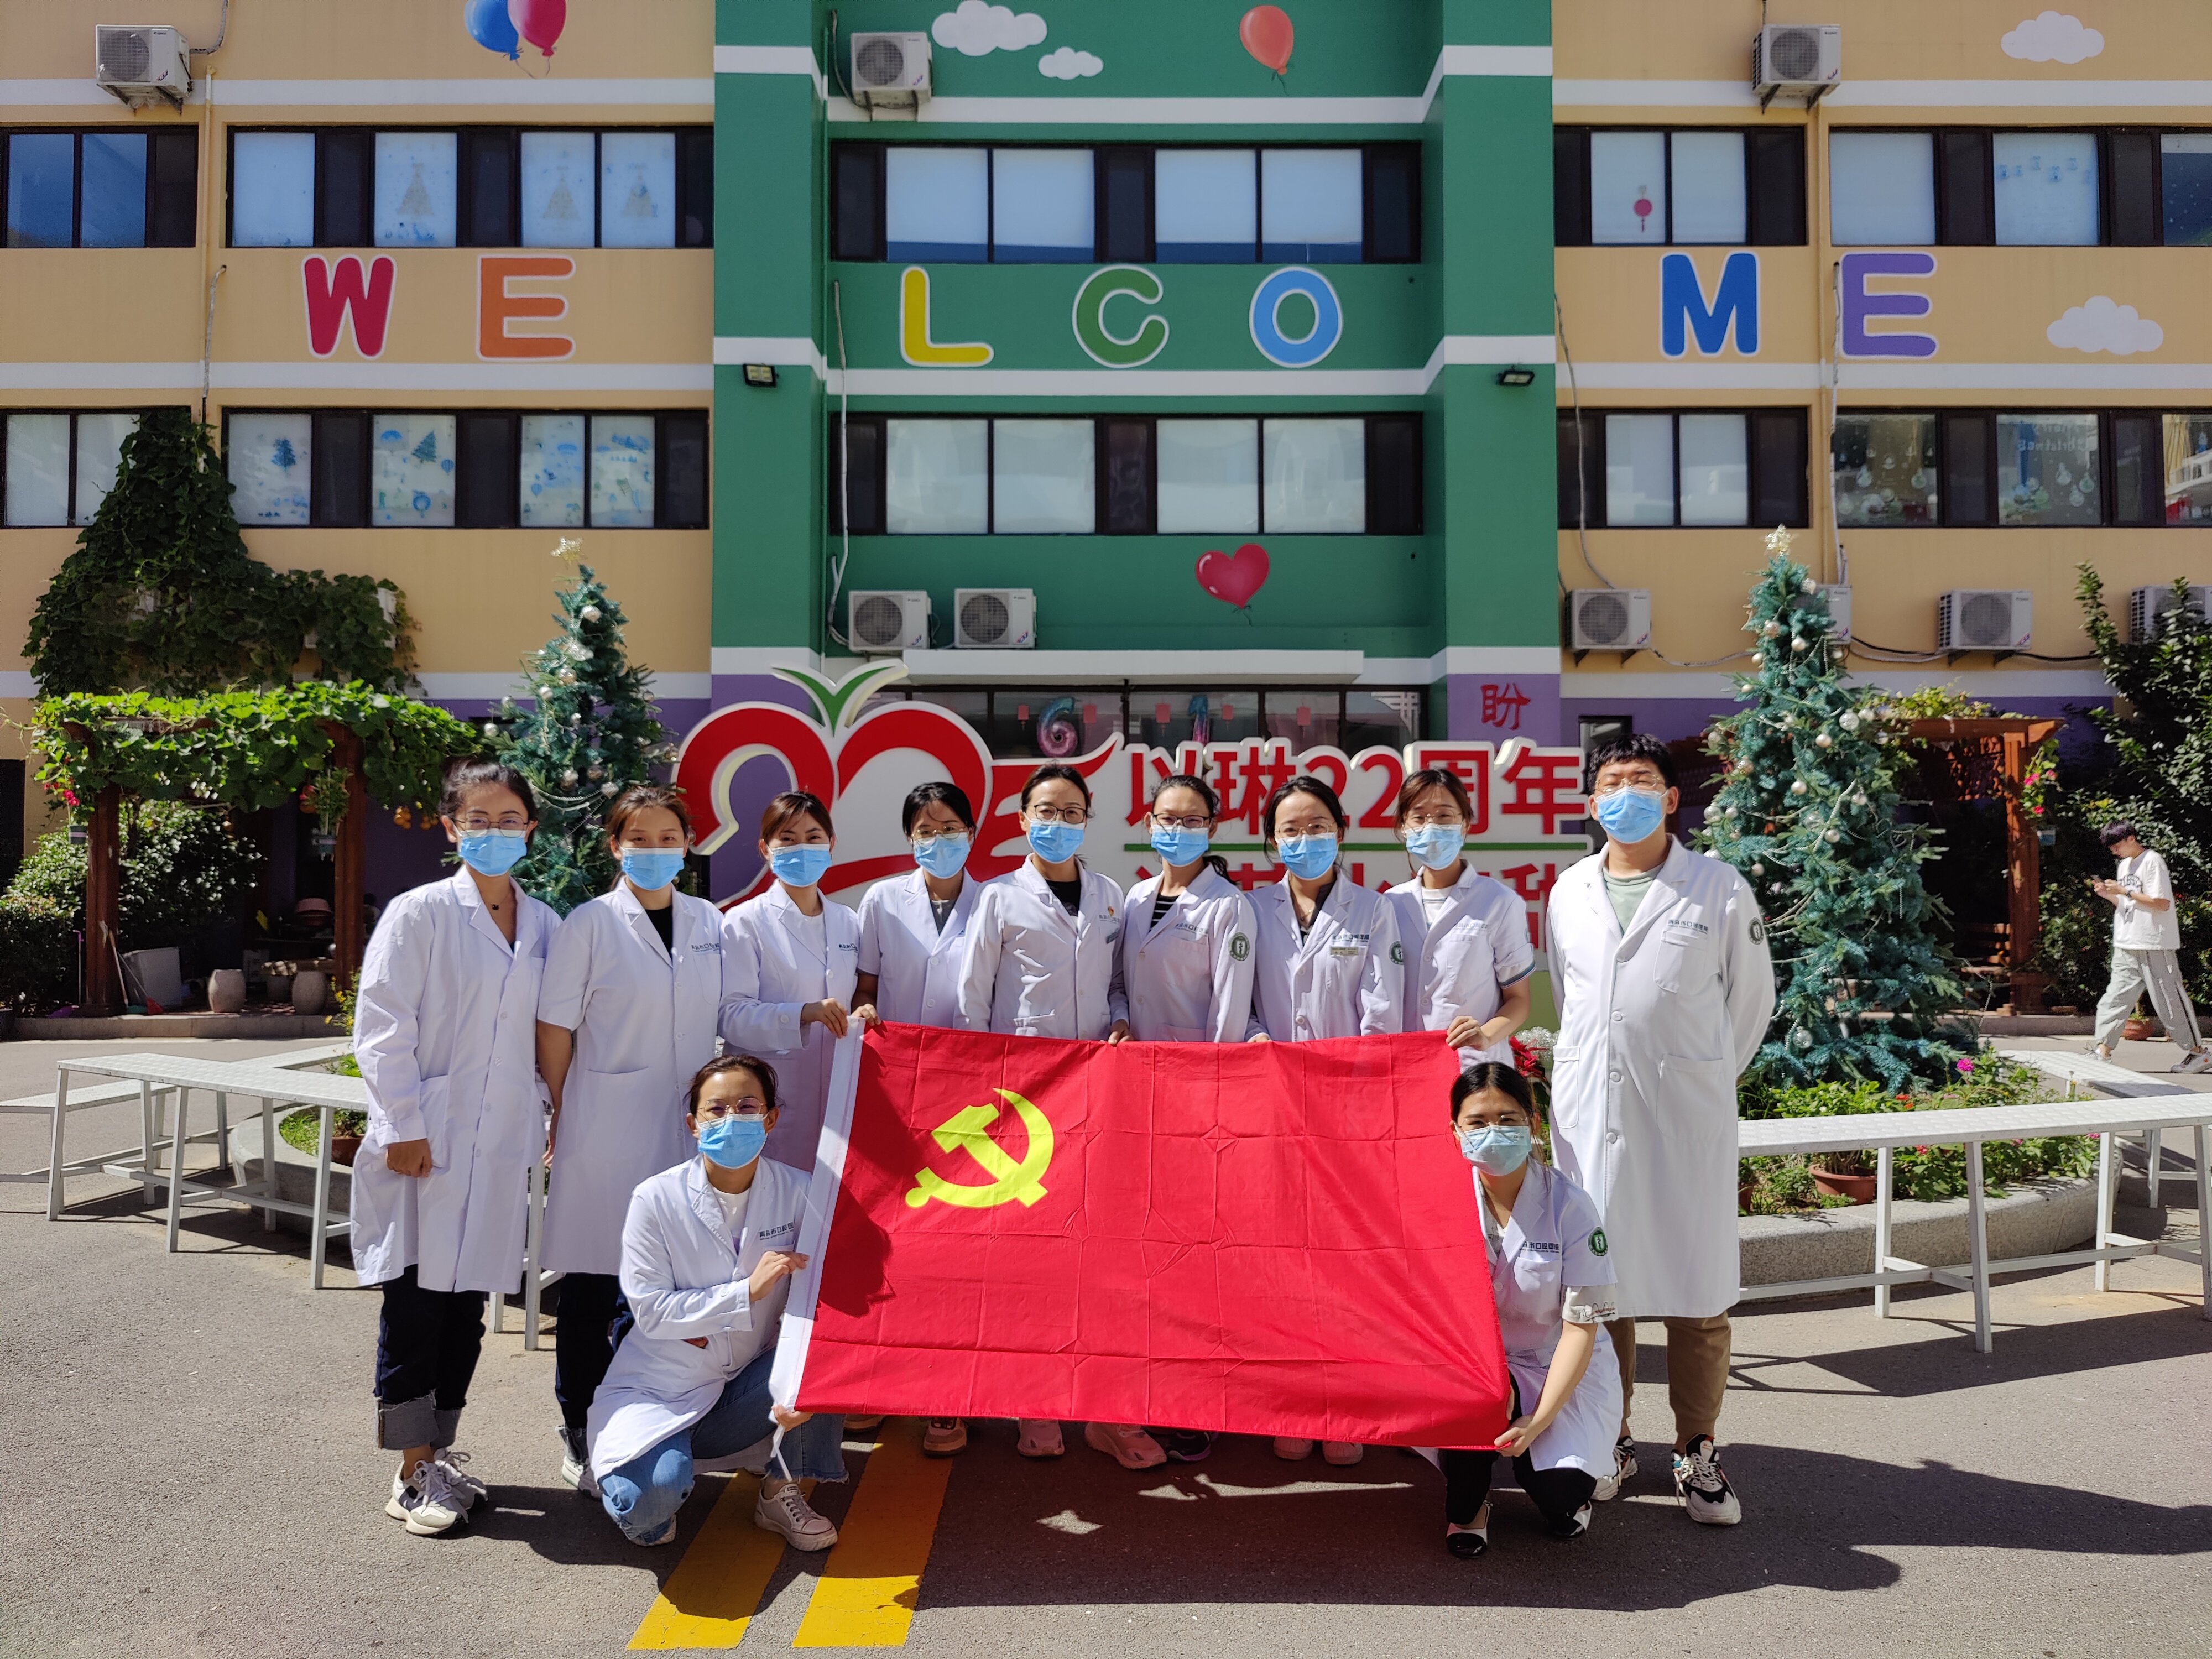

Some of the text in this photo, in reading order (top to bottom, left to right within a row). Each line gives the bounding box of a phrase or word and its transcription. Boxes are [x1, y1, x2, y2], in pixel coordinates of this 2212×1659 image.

[1480, 683, 1531, 731] 盼
[1126, 747, 1585, 835] 以琳22周年
